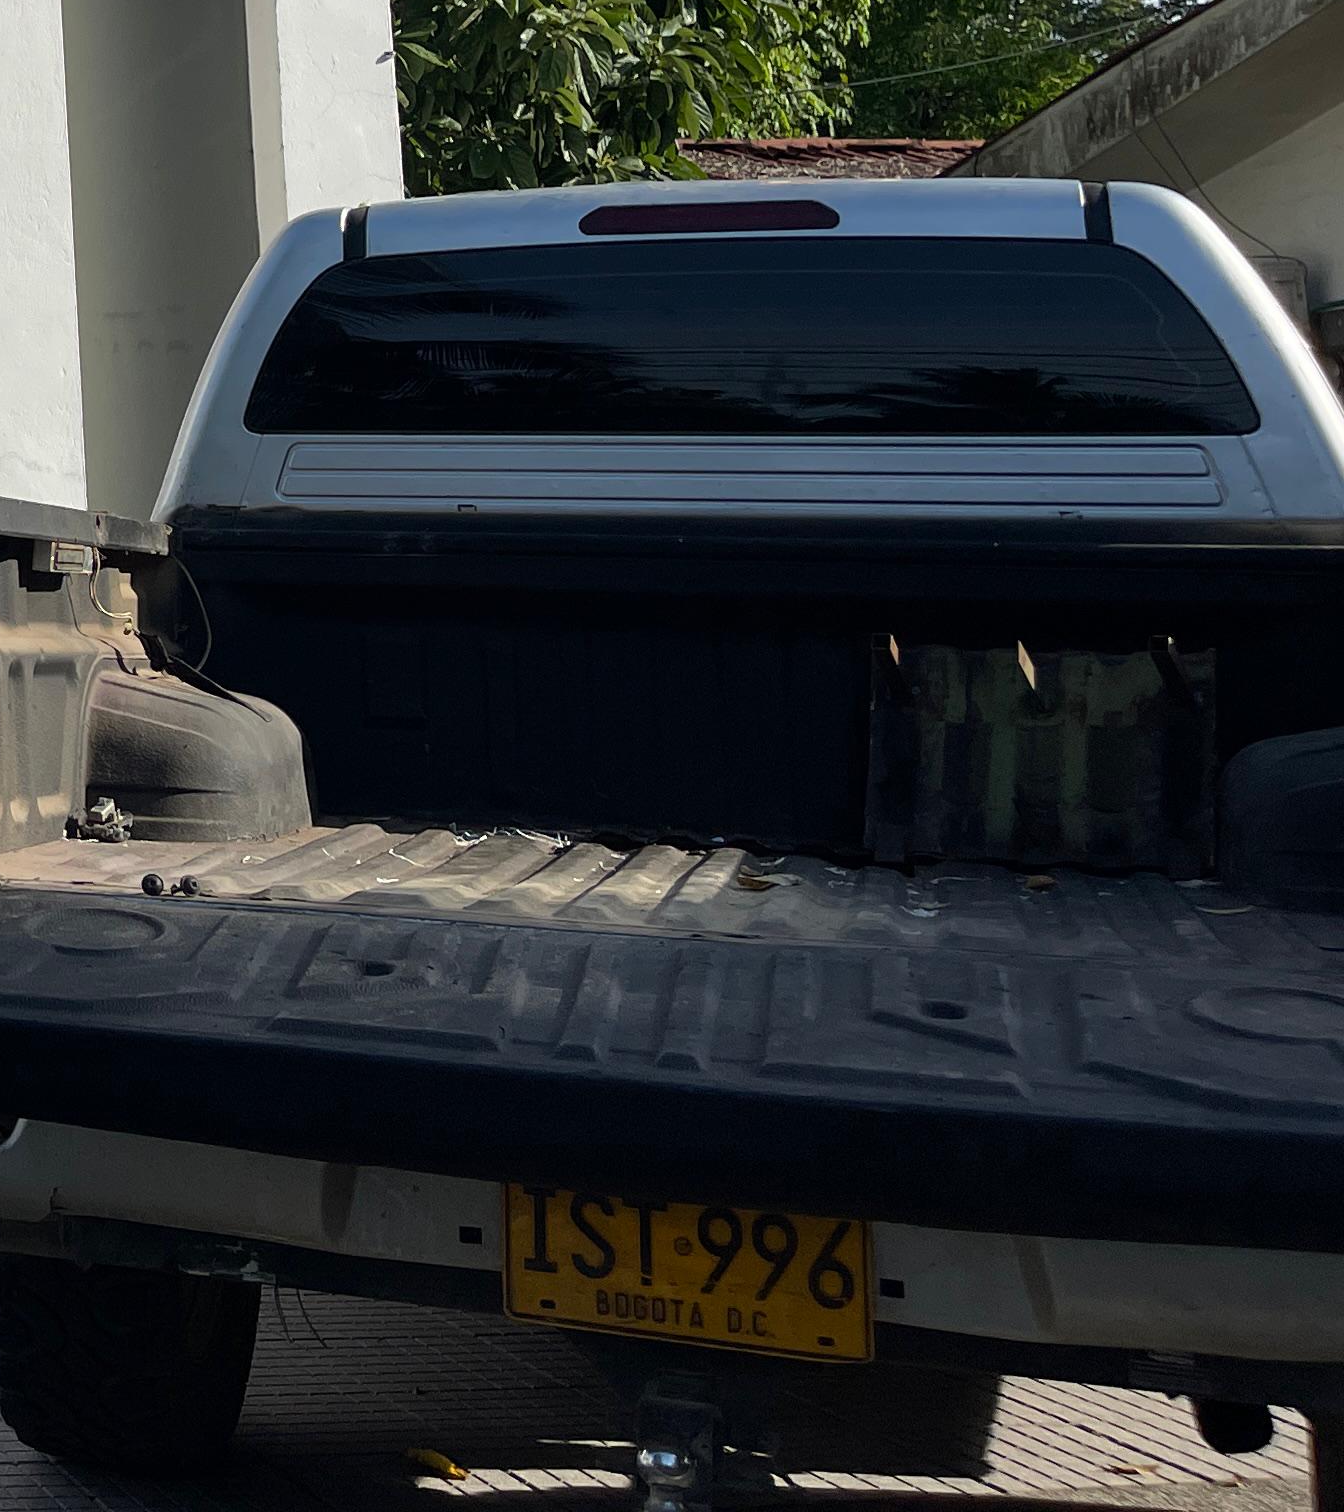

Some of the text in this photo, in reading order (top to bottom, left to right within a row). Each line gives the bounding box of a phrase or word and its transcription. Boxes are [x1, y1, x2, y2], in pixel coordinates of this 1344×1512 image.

[523, 1189, 855, 1311] IST 996
[596, 1289, 705, 1329] BOGOTA
